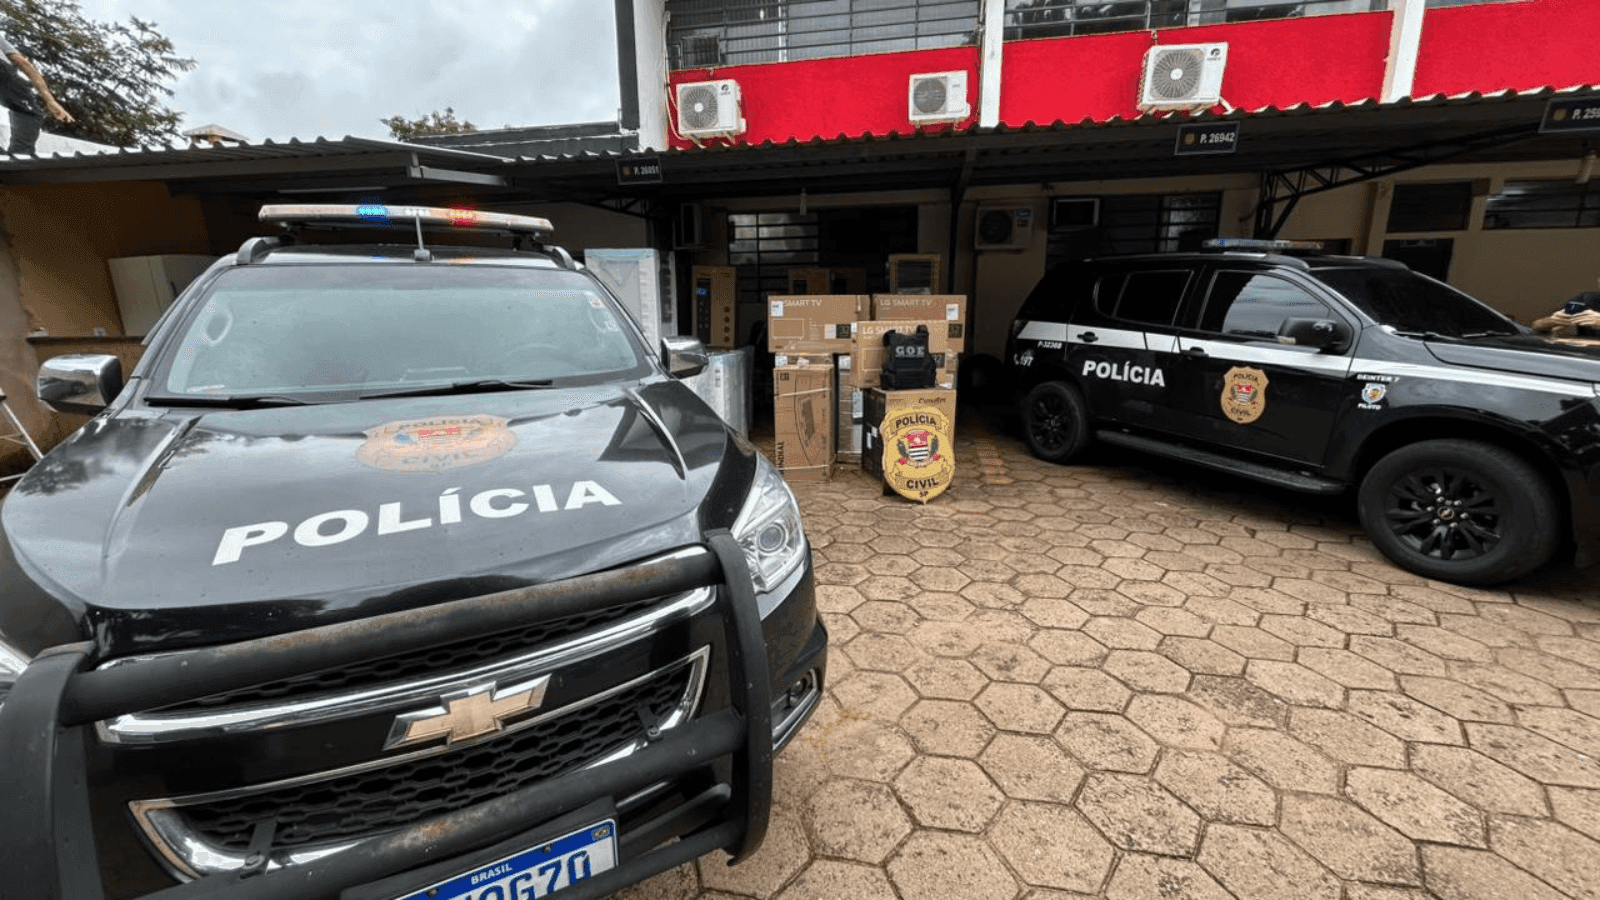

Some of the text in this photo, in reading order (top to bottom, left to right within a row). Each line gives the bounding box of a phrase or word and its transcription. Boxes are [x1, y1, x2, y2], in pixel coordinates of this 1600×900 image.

[1199, 131, 1236, 144] P. 26942
[811, 299, 822, 307] TV
[862, 326, 875, 335] LG
[1082, 360, 1166, 387] POLÍCIA
[895, 413, 937, 429] POLÍCIA
[906, 477, 939, 489] CIVIL
[212, 480, 622, 566] POLÍCIA
[470, 862, 514, 886] BRASIL
